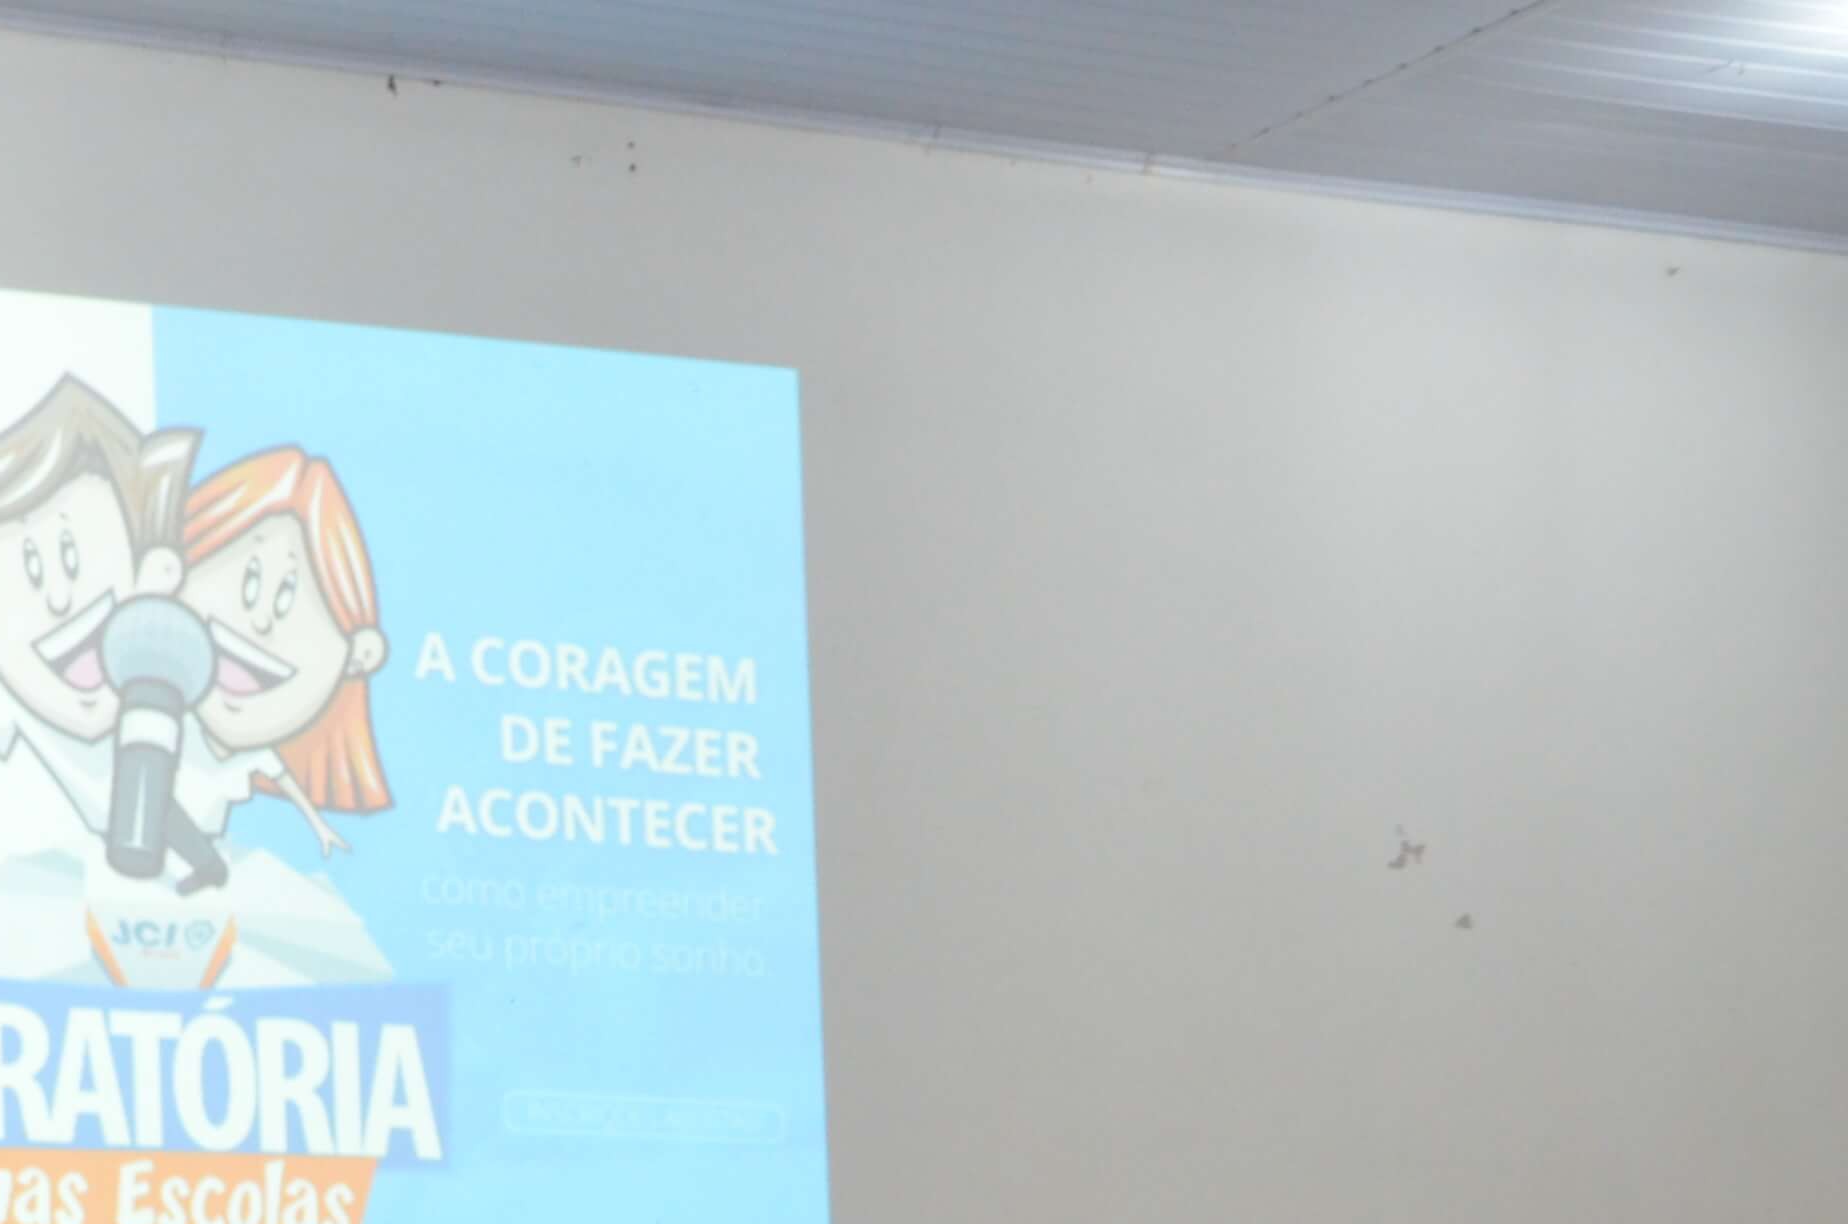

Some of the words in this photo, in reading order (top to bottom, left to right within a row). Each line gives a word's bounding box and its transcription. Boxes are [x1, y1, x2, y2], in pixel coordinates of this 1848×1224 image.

[414, 632, 456, 682] A
[470, 636, 758, 704] CORAGEM
[500, 714, 573, 766] DE
[590, 721, 760, 778] FAZER
[436, 784, 778, 855] ACONTECER
[421, 875, 523, 910] como
[112, 918, 176, 946] JCI
[426, 929, 494, 960] seu
